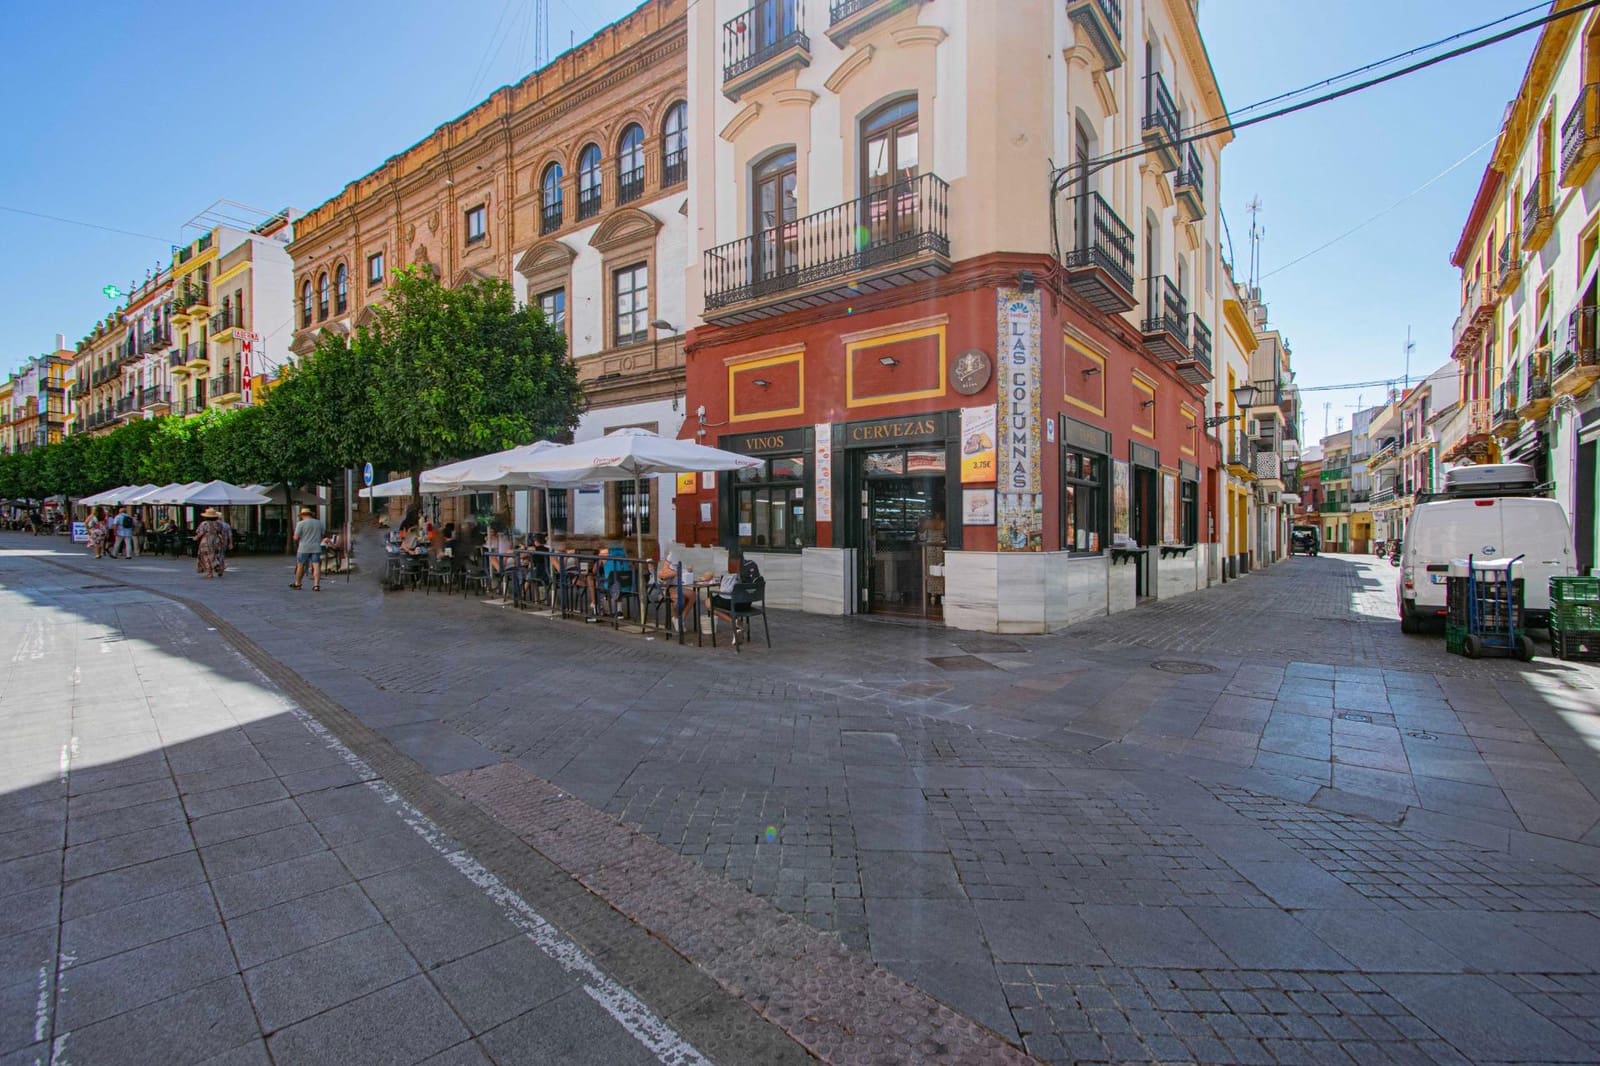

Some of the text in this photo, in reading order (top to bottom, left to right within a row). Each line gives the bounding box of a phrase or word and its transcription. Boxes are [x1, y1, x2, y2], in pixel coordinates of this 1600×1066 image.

[1012, 322, 1026, 365] LAS
[242, 340, 252, 403] MIAMI
[746, 435, 784, 449] VINOS
[853, 420, 935, 441] CERVEZAS
[1013, 373, 1027, 488] COLUMNAS
